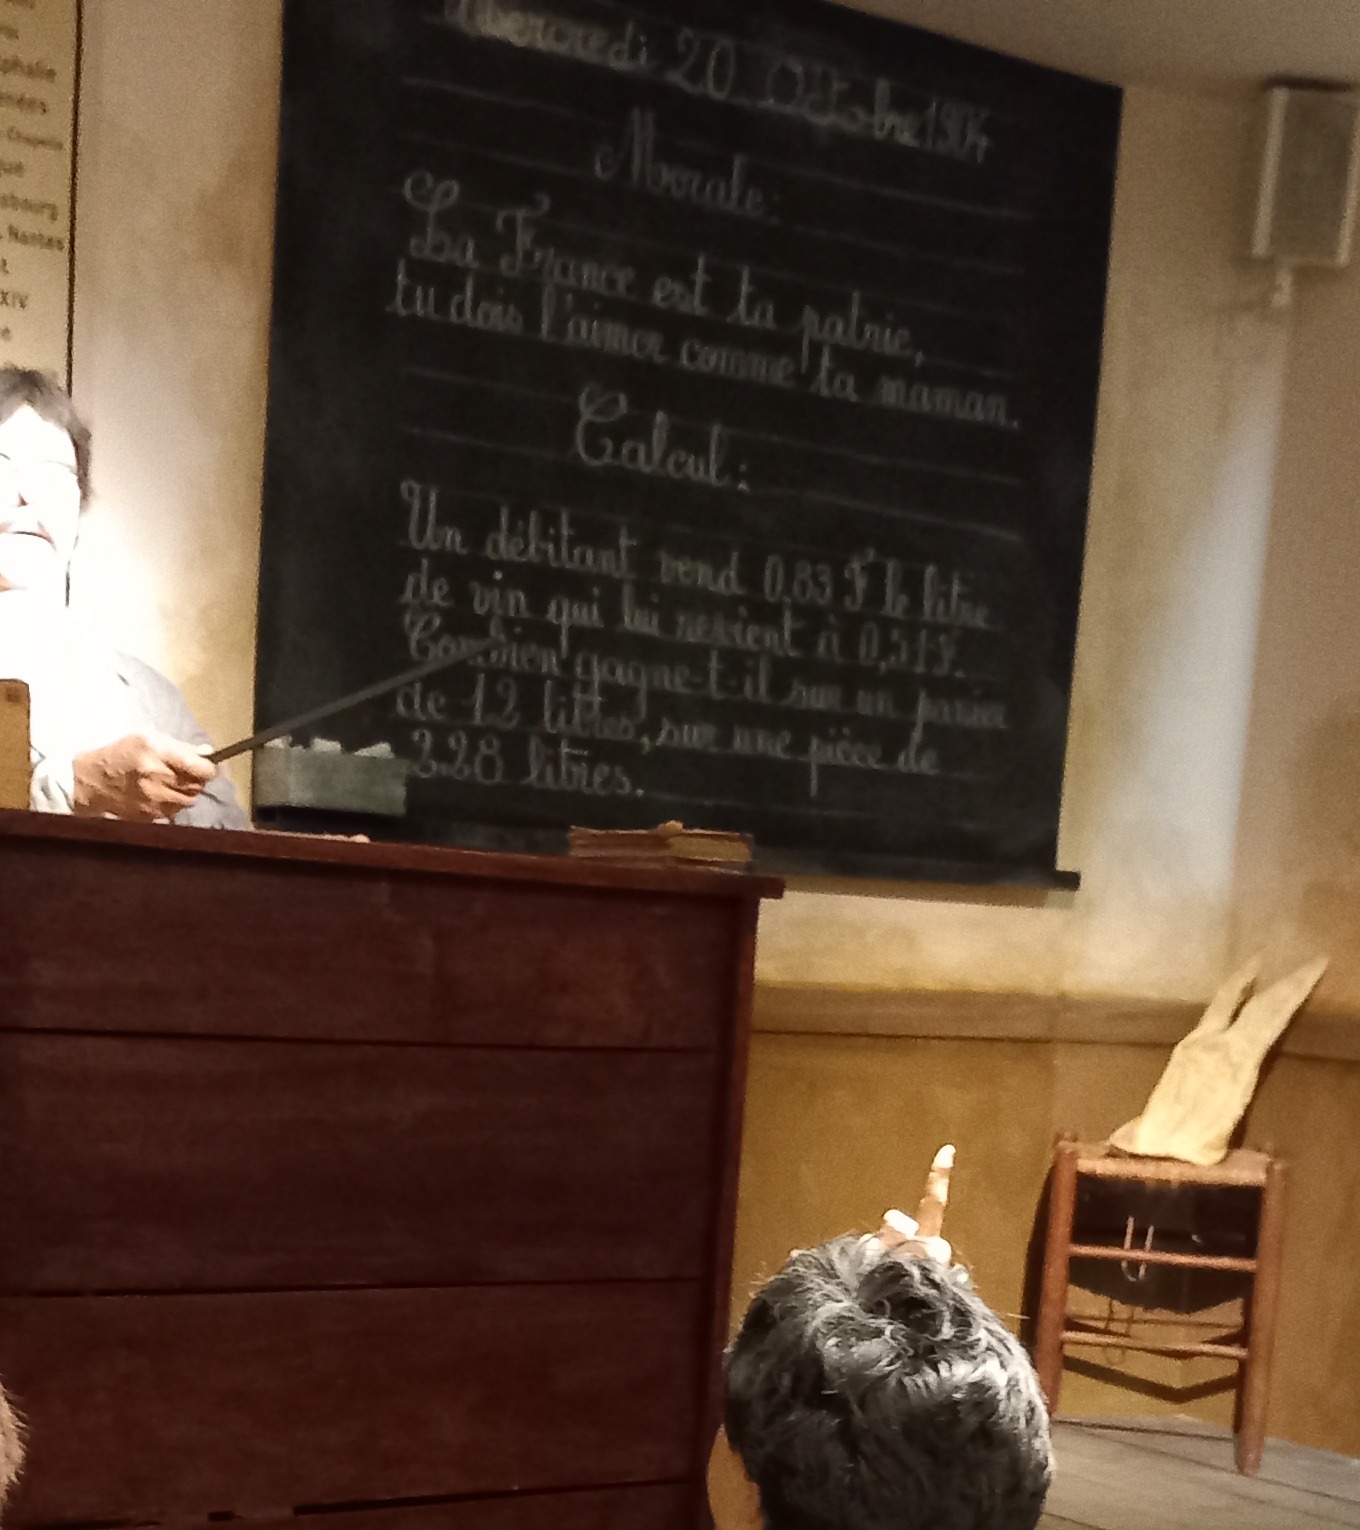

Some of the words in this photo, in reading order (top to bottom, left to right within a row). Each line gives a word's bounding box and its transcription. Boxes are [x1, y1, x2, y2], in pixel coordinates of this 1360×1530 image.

[665, 28, 735, 100] 20
[401, 168, 480, 270] La
[495, 191, 638, 298] France
[651, 252, 712, 317] est
[727, 264, 776, 330] ta
[792, 290, 925, 373] patrie,
[386, 258, 440, 319] tu
[450, 274, 524, 333] dois
[541, 284, 668, 364] l'aimer
[680, 338, 798, 389] comme
[810, 345, 858, 402] ta
[877, 372, 1019, 428] maman.
[399, 479, 468, 556] Un
[486, 505, 638, 579] débitant
[657, 548, 746, 596] vend
[884, 557, 911, 620] le
[922, 563, 992, 630] litre
[400, 557, 453, 607] de
[469, 570, 529, 618] vin
[546, 586, 602, 658] qui
[621, 579, 662, 637] lui
[676, 597, 801, 659] revient
[816, 612, 840, 663] à
[397, 682, 446, 720] de
[472, 673, 521, 729] 12
[655, 717, 718, 754] sur
[734, 723, 792, 761] une
[897, 735, 938, 776] de
[787, 676, 842, 711] sur
[856, 689, 896, 719] un
[411, 728, 504, 786] 228
